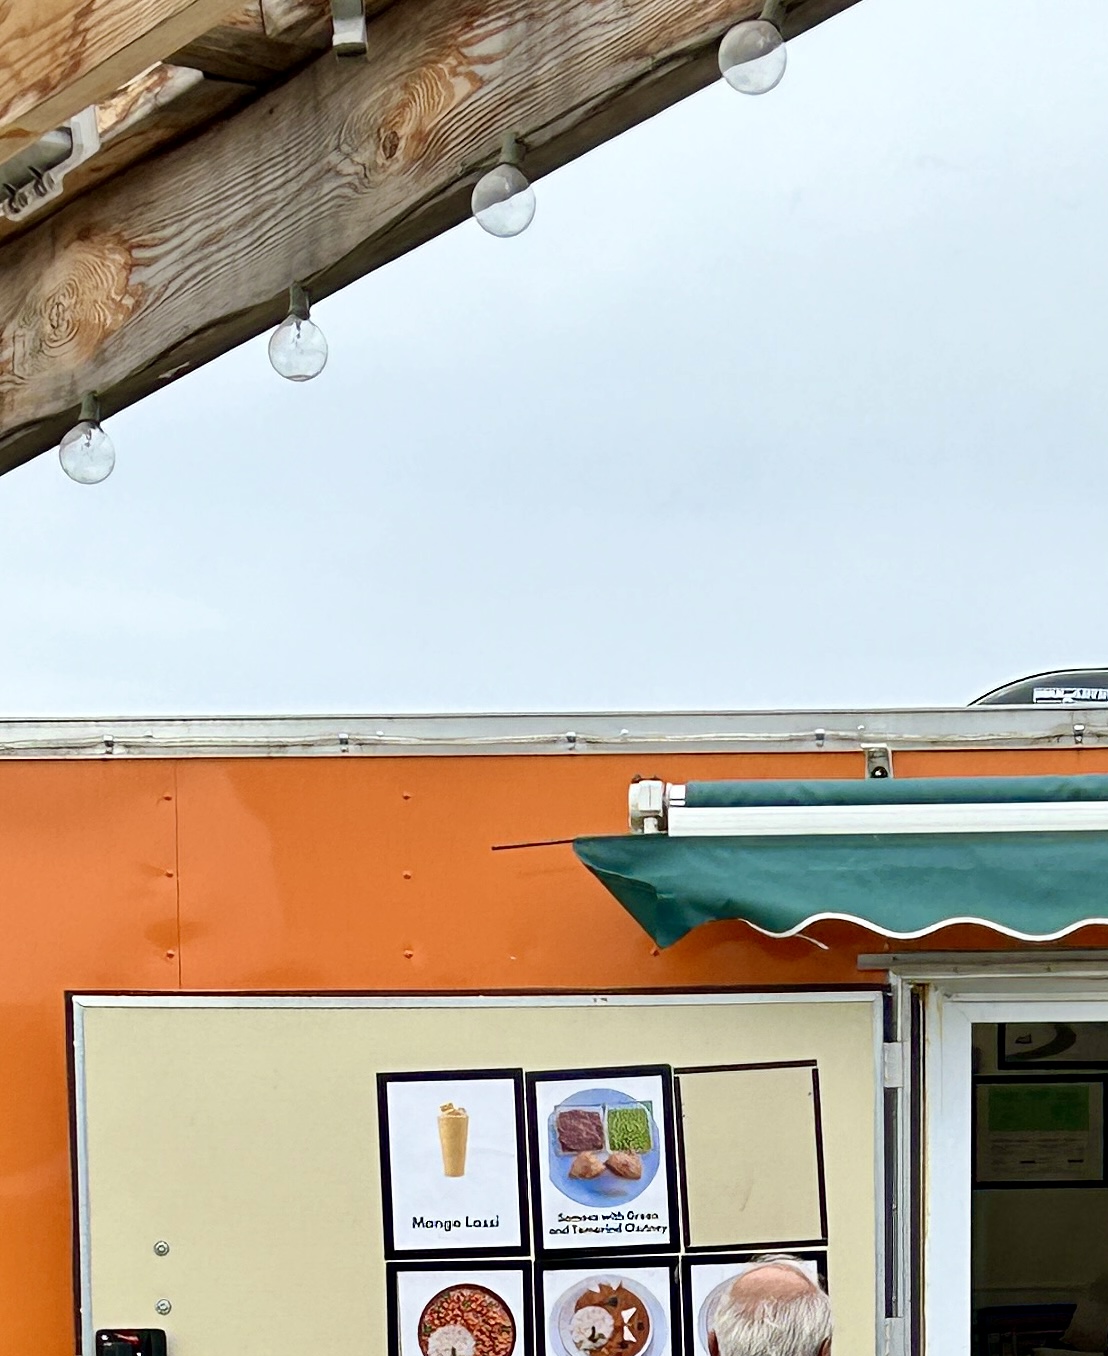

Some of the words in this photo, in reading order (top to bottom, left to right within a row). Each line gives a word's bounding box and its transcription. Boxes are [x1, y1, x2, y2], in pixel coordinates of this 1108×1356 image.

[627, 1210, 659, 1220] Green
[412, 1216, 461, 1232] Mango
[465, 1214, 499, 1228] Lassi
[549, 1225, 570, 1234] and
